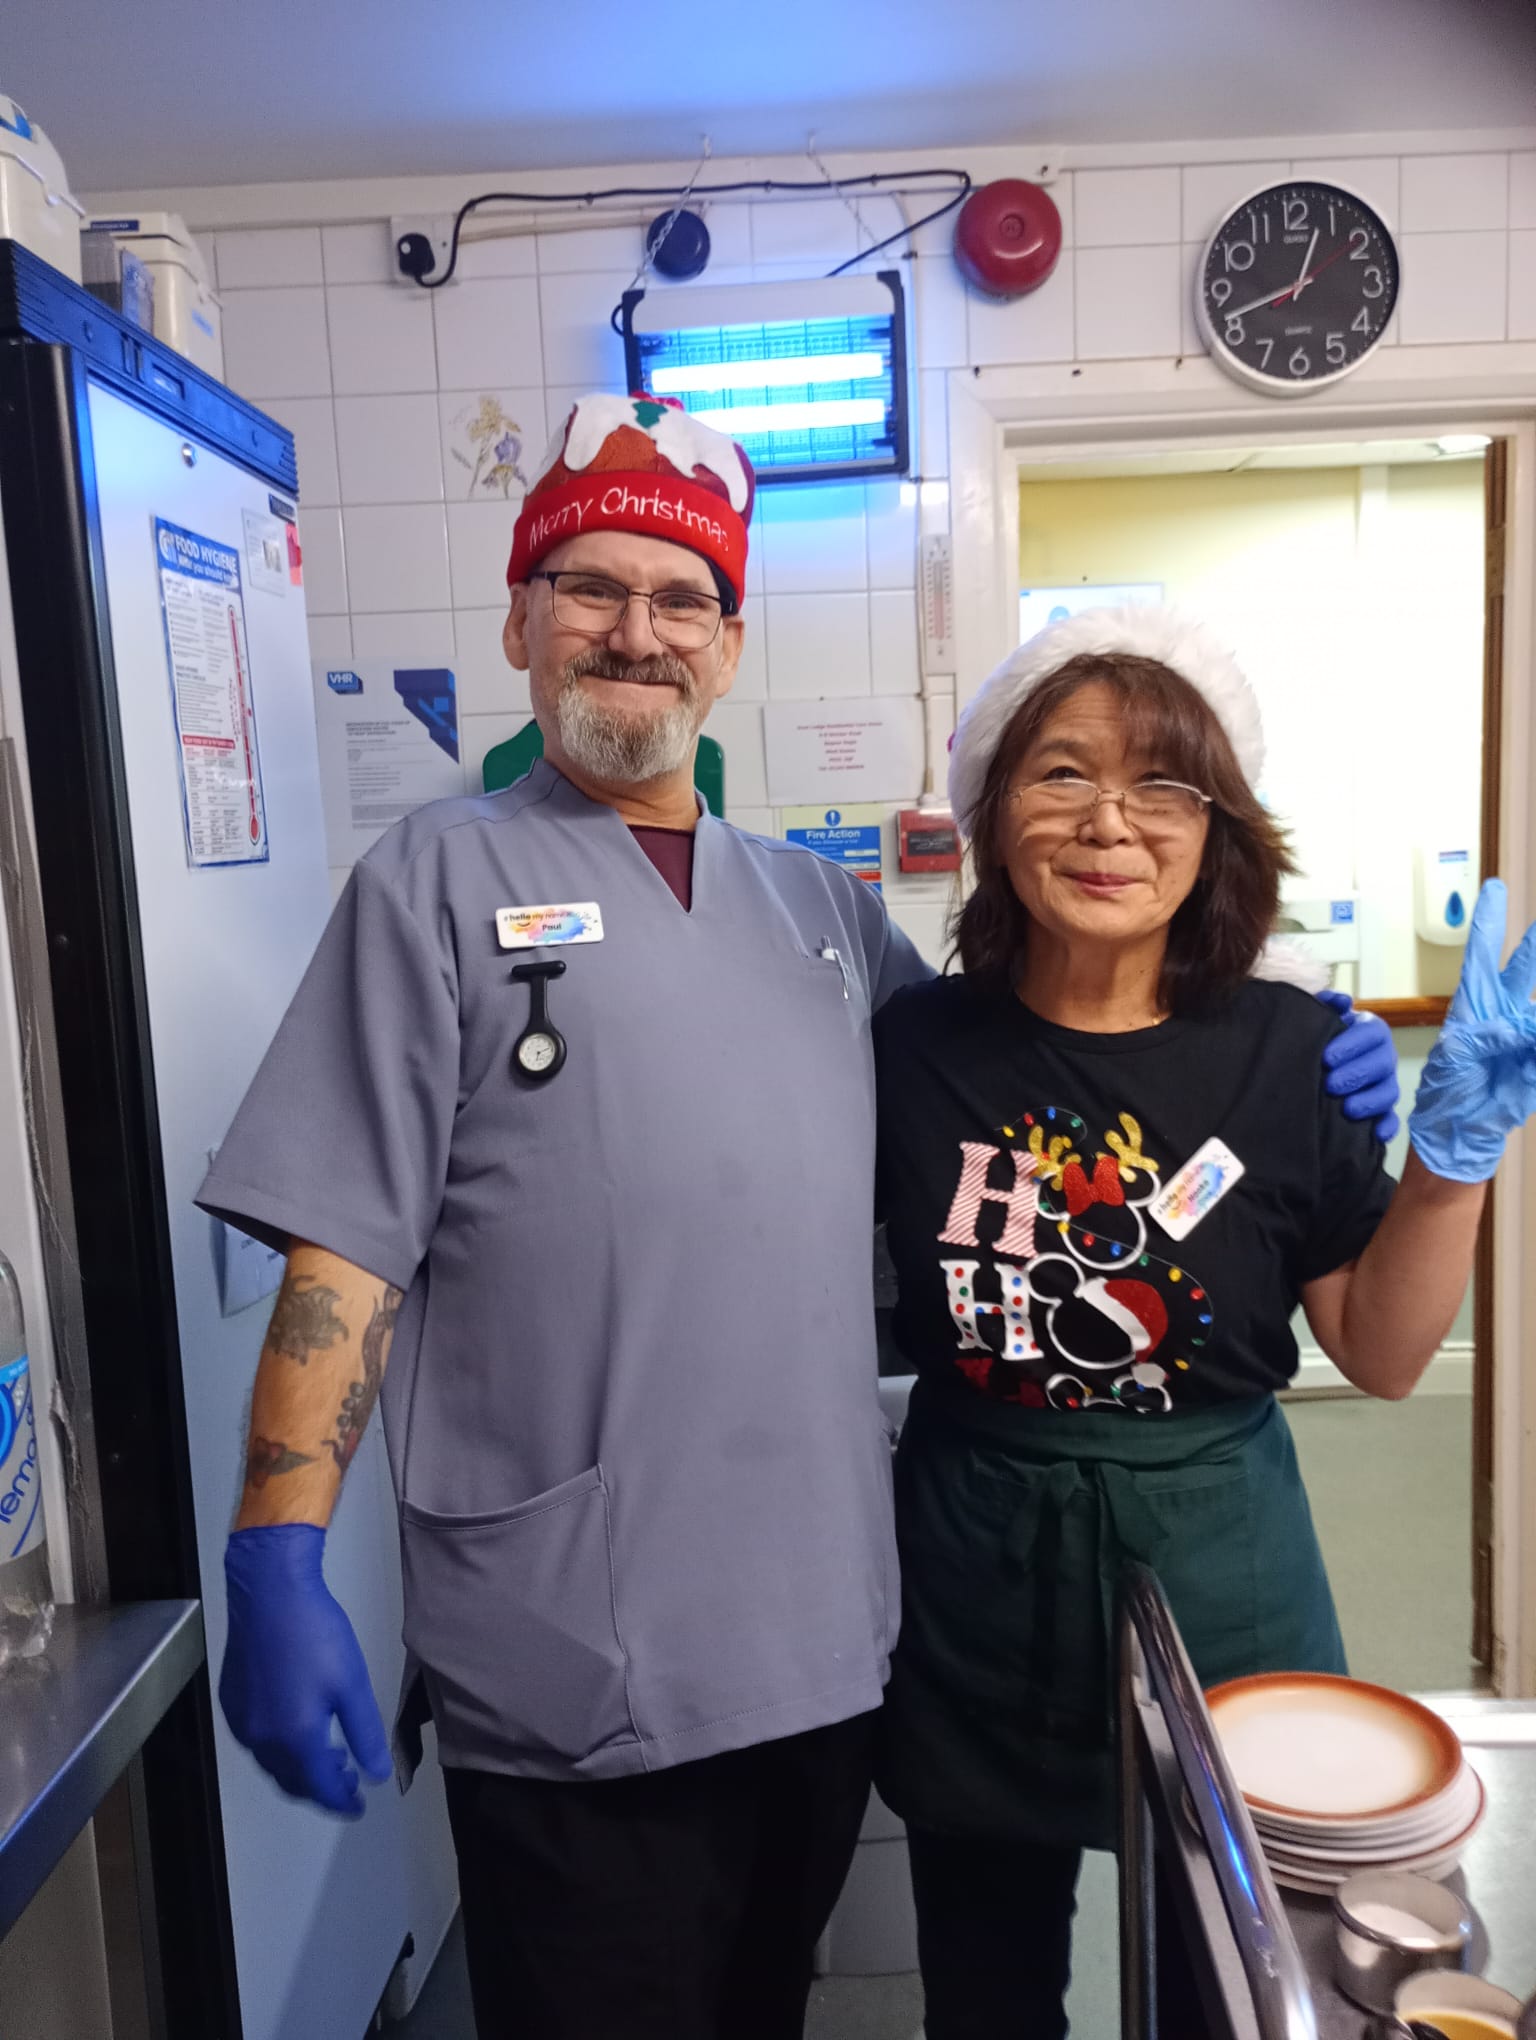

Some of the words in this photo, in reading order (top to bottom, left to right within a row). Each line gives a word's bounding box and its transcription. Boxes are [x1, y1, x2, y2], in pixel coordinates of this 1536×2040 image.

[1250, 212, 1270, 245] 11
[1282, 199, 1309, 230] 12
[1327, 203, 1336, 237] 1
[1223, 240, 1255, 273] 10
[1348, 229, 1371, 261] 2
[1210, 278, 1233, 309] 9
[1362, 265, 1384, 299] 3
[1224, 315, 1246, 346] 8
[1351, 305, 1371, 336] 4
[1255, 337, 1275, 369] 7
[1288, 346, 1310, 376] 6
[1325, 332, 1346, 364] 5
[529, 498, 594, 552] Merry
[175, 534, 200, 559] FOOD
[200, 545, 238, 574] HYGIENE
[329, 673, 353, 684] VHR
[806, 830, 826, 840] Fire
[828, 829, 861, 839] Action
[542, 923, 562, 931] Paul
